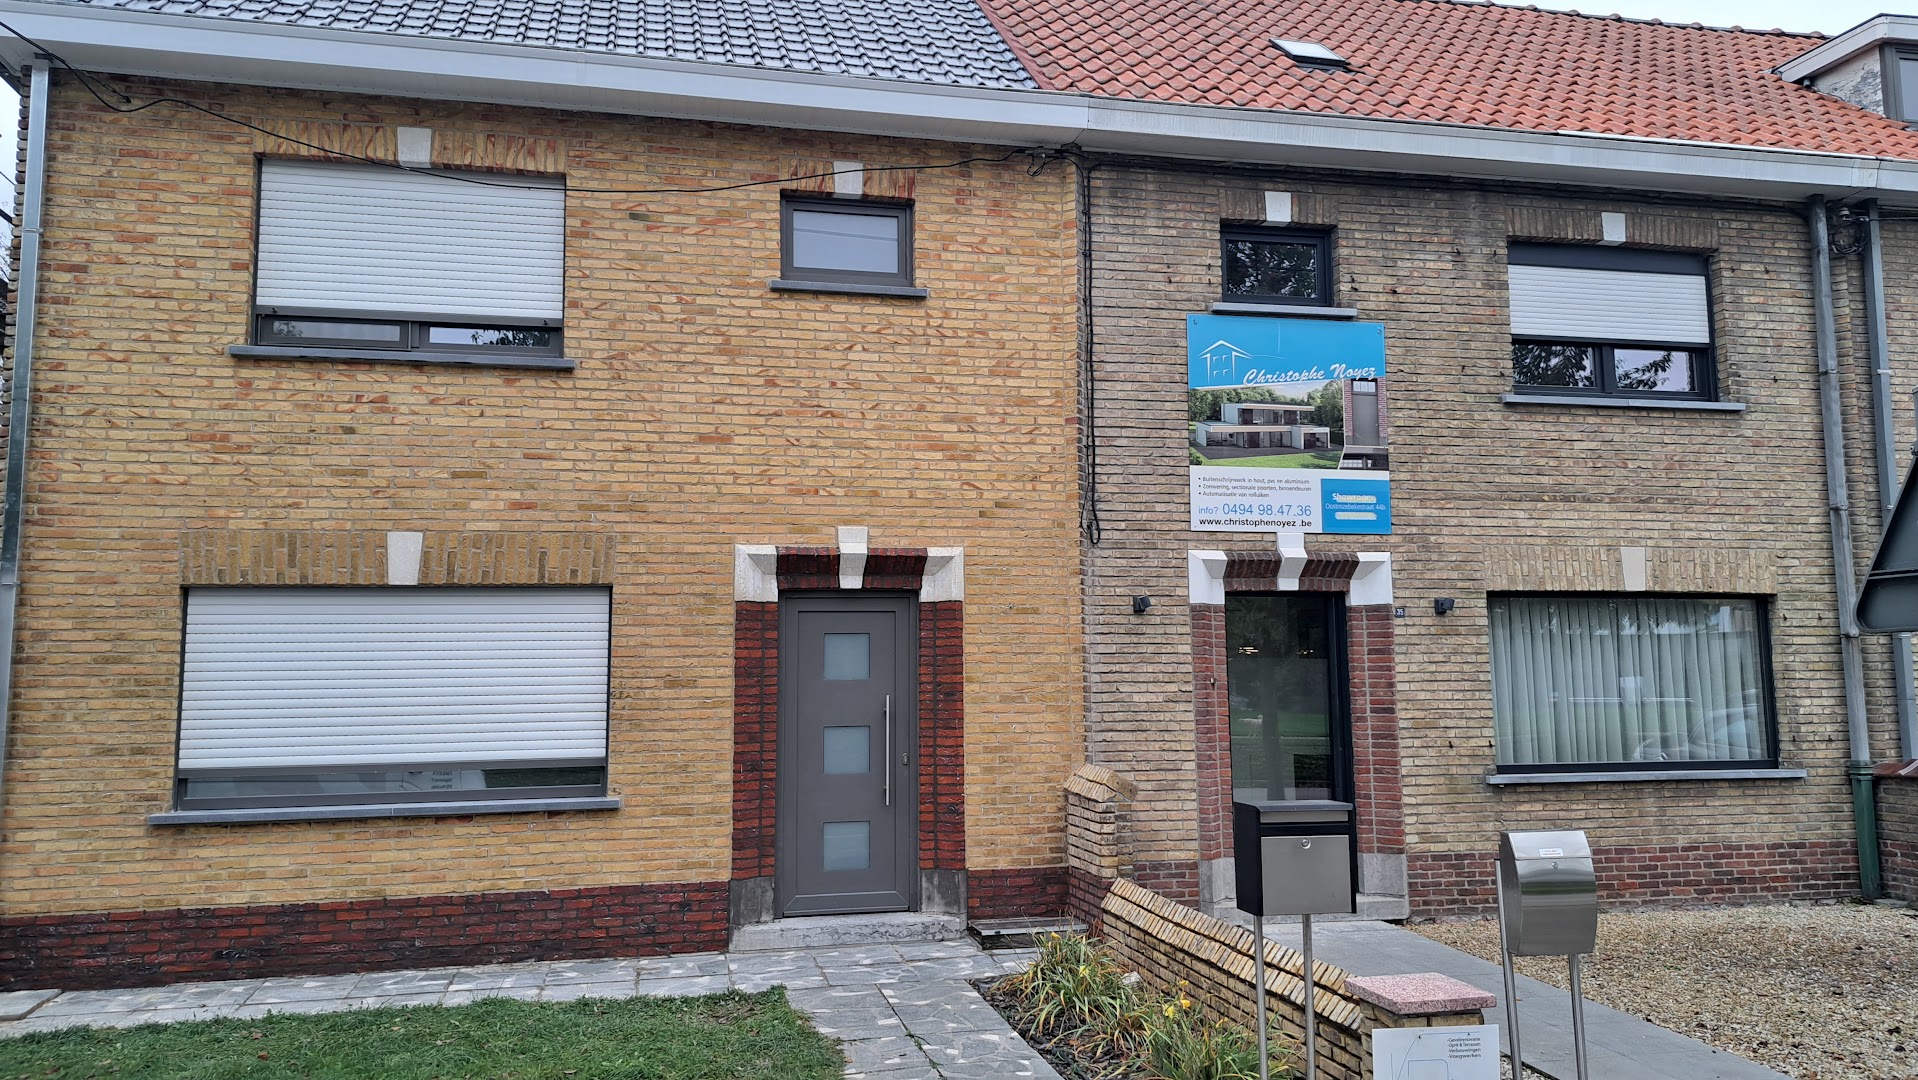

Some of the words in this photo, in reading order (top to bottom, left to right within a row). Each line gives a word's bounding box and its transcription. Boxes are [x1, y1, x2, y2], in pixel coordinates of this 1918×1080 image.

[1243, 366, 1325, 386] Christophe
[1330, 363, 1376, 380] Noyez
[1198, 506, 1218, 515] info?
[1222, 503, 1253, 515] 0494
[1258, 504, 1312, 516] 98.47.36
